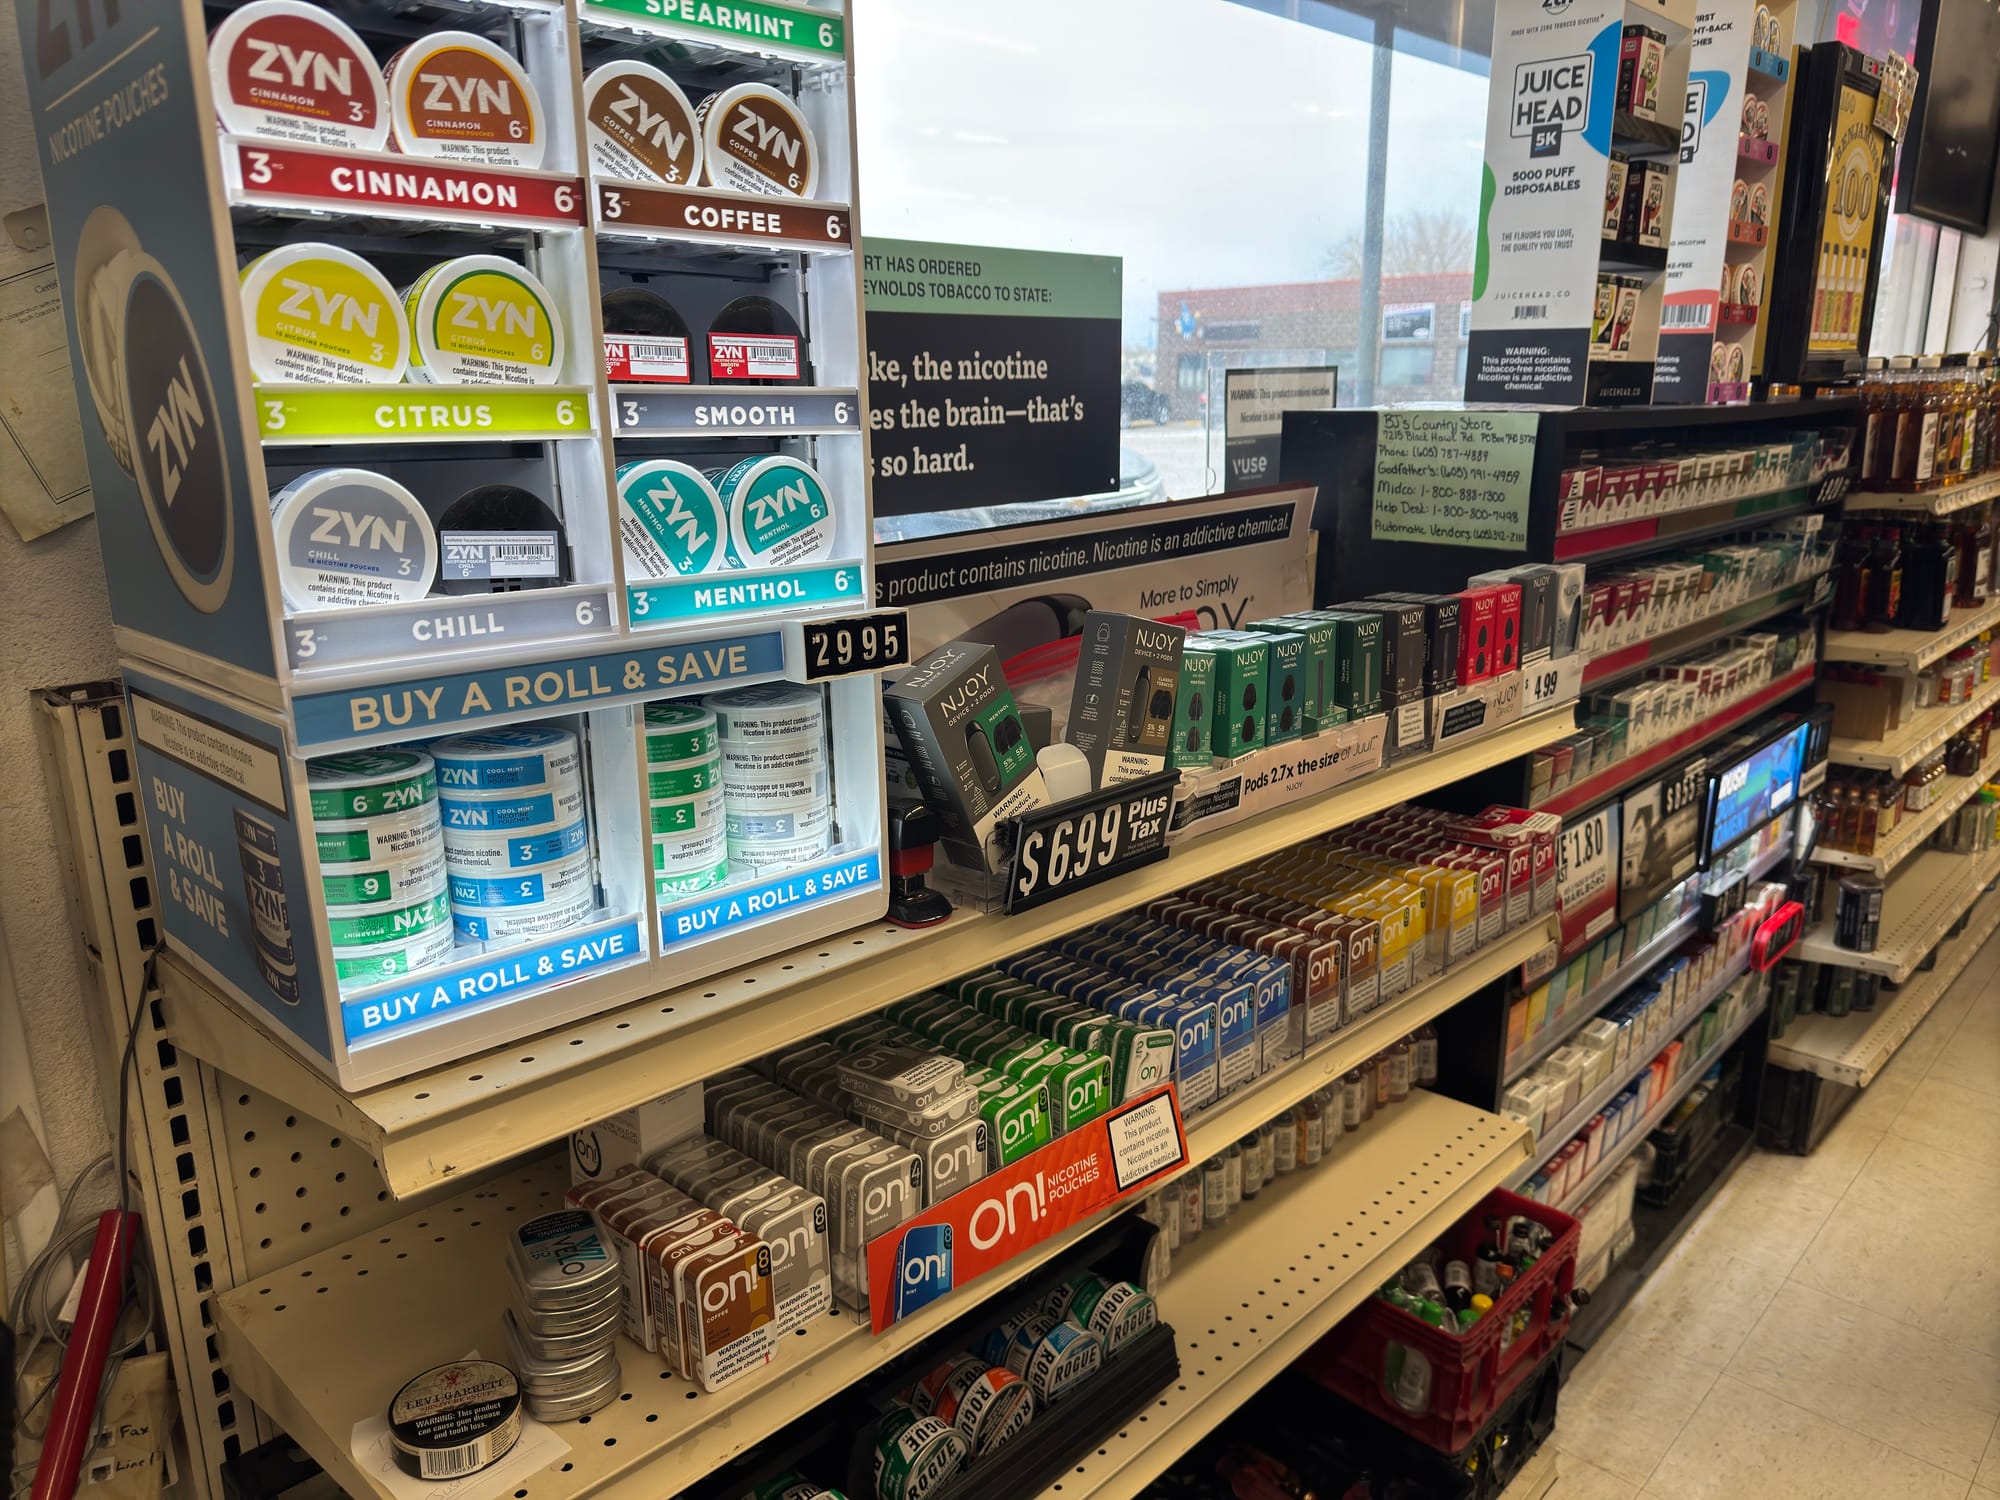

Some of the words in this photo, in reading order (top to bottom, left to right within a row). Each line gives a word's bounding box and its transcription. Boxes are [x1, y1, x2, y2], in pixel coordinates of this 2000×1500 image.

[646, 0, 794, 40] SPEARMINT
[818, 23, 834, 47] 6
[247, 38, 353, 96] ZYN
[1519, 64, 1585, 95] JUICE
[250, 87, 315, 107] CINNAMON
[420, 73, 511, 115] ZYN
[50, 115, 104, 164] NICOTINE
[104, 64, 168, 128] POUCHES
[348, 101, 364, 122] 3
[1517, 96, 1582, 126] HEAD
[265, 115, 301, 130] WARNING:
[302, 121, 320, 134] This
[321, 124, 347, 138] product
[603, 115, 634, 143] COFFEE
[1535, 134, 1557, 147] 5K
[248, 152, 272, 183] 3
[330, 167, 518, 208] CINNAMON
[554, 186, 574, 213] 6
[1504, 180, 1580, 196] DISPOSABLES
[1512, 171, 1543, 182] 5000
[1545, 167, 1575, 178] PUFF
[1832, 166, 1872, 221] 100
[604, 192, 622, 218] 3
[684, 205, 782, 233] COFFEE
[826, 216, 841, 238] 6
[1502, 232, 1512, 241] THE
[1514, 231, 1540, 240] FLAVORS
[1543, 230, 1555, 239] YOU
[1557, 229, 1574, 238] LOVE,
[886, 257, 914, 273] HAS
[919, 258, 981, 277] ORDERED
[929, 283, 991, 301] TOBACCO
[995, 286, 1010, 301] TO
[1014, 288, 1052, 303] STATE:
[1495, 290, 1571, 300] JUICEHEAD.CO
[278, 278, 380, 338] ZYN
[1505, 347, 1550, 356] WARNING:
[913, 352, 953, 381] the
[958, 351, 1048, 380] nicotine
[1483, 365, 1532, 375] tobacco-free
[1535, 365, 1571, 374] nicotine.
[264, 401, 285, 430] 3
[375, 406, 492, 428] CITRUS
[556, 400, 575, 425] 6
[623, 402, 640, 426] 3
[694, 406, 796, 426] SMOOTH
[834, 402, 849, 424] 6
[900, 400, 940, 428] the
[1384, 415, 1410, 430] BJ's
[1412, 413, 1457, 435] Country
[1460, 417, 1493, 431] Store
[147, 354, 204, 508] ZYN
[881, 455, 907, 477] so
[913, 444, 974, 474] hard.
[1232, 456, 1267, 475] vuse
[1378, 445, 1409, 457] Phone:
[1412, 446, 1438, 458] (605)
[1440, 466, 1469, 480] (605)
[646, 476, 708, 554] ZYN
[747, 477, 812, 531] ZYN
[1376, 500, 1398, 514] Help
[310, 507, 407, 553] ZYN
[758, 522, 790, 543] MENTHOL
[1375, 519, 1426, 536] Automatic
[308, 550, 340, 561] CHILL
[316, 558, 347, 569] NICOTINE
[349, 562, 380, 572] POUCHES
[888, 566, 955, 602] product
[959, 555, 1025, 583] contains
[1029, 546, 1089, 573] nicotine.
[1093, 535, 1148, 563] Nicotine
[1150, 533, 1161, 552] is
[1164, 535, 1180, 552] an
[1182, 524, 1235, 550] addictive
[1237, 511, 1290, 540] chemical.
[318, 573, 351, 585] WARNING:
[352, 578, 370, 588] This
[371, 581, 392, 591] product
[633, 591, 650, 615] 3
[694, 579, 806, 609] MENTHOL
[834, 570, 850, 591] 6
[1139, 588, 1177, 609] More
[1179, 586, 1193, 600] to
[1195, 574, 1240, 601] Simply
[1475, 598, 1495, 611] NJOY
[295, 629, 317, 657] 3
[412, 612, 505, 641] CHILL
[576, 601, 594, 625] 6
[1136, 628, 1178, 652] NJOY
[1237, 649, 1265, 667] NJOY
[351, 687, 445, 732] BUY
[461, 682, 492, 715] A
[505, 666, 612, 708] ROLL
[623, 660, 645, 690] &
[657, 645, 747, 685] SAVE
[939, 665, 990, 719] NJOY
[1535, 671, 1558, 700] 4.99
[733, 720, 759, 728] WARNING:
[760, 720, 772, 728] This
[773, 718, 792, 728] product
[988, 703, 1009, 723] MENTHOL
[442, 768, 479, 785] ZYN
[1245, 772, 1269, 795] Pods
[1271, 762, 1294, 785] 2.7x
[1297, 758, 1318, 777] the
[1319, 752, 1340, 770] size
[153, 777, 187, 824] BUY
[1130, 817, 1161, 842] Tax
[163, 824, 176, 856] A
[176, 831, 225, 892] ROLL
[1019, 804, 1122, 896] $6.99
[1128, 796, 1168, 823] Plus
[169, 868, 182, 903] &
[183, 883, 230, 938] SAVE
[1310, 955, 1334, 981] on!
[1180, 1018, 1209, 1050] on!
[1068, 1078, 1103, 1111] on!
[1123, 1105, 1156, 1127] WARNING:
[1124, 1126, 1139, 1140] This
[1138, 1117, 1162, 1135] product
[1049, 1168, 1100, 1203] POUCHES
[969, 1171, 1048, 1250] on!
[1048, 1153, 1098, 1186] NICOTINE
[704, 1265, 759, 1312] on!
[706, 1309, 729, 1324] COFFEE
[718, 1337, 751, 1356] WARNING:
[752, 1328, 765, 1340] This
[1054, 1346, 1097, 1384] ROGUE
[445, 1378, 504, 1400] GARRETT
[415, 1412, 456, 1429] WARNING:
[457, 1408, 473, 1420] This
[474, 1402, 501, 1416] product
[120, 1424, 149, 1438] Fax
